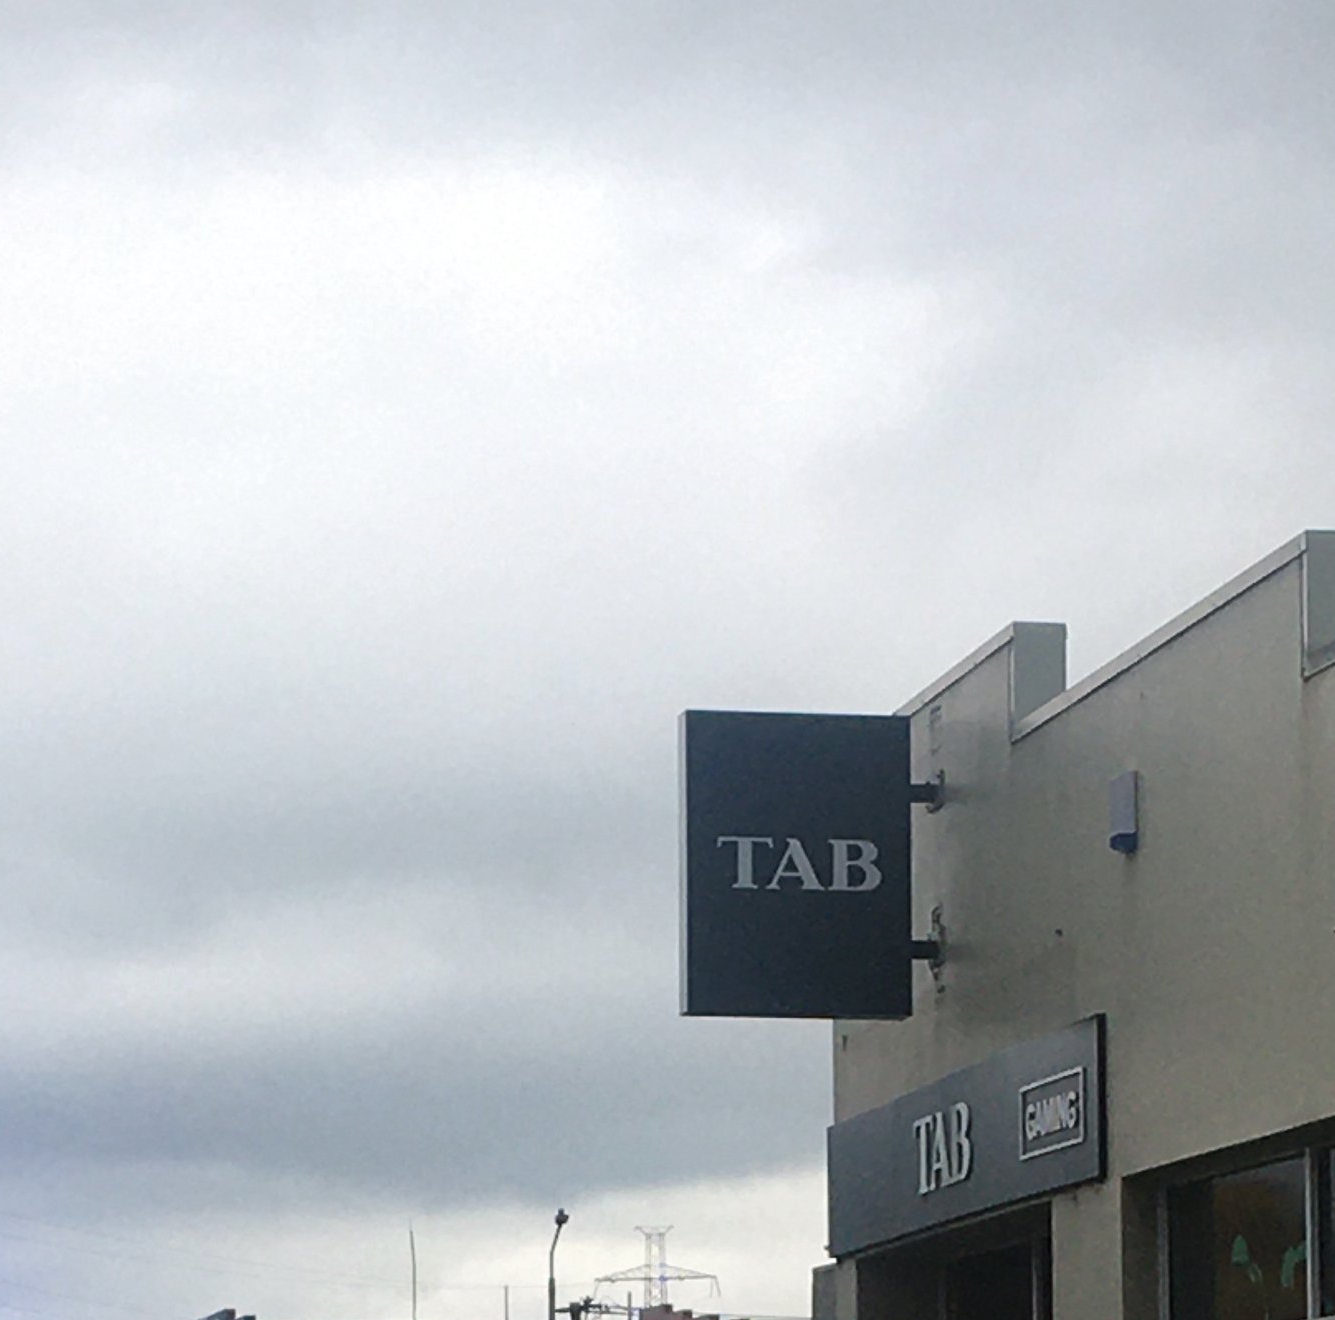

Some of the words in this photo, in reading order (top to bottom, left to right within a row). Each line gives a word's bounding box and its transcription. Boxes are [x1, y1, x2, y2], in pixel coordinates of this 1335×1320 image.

[716, 835, 883, 892] TAB
[913, 1101, 972, 1196] TAB
[1025, 1090, 1078, 1141] GAMING
